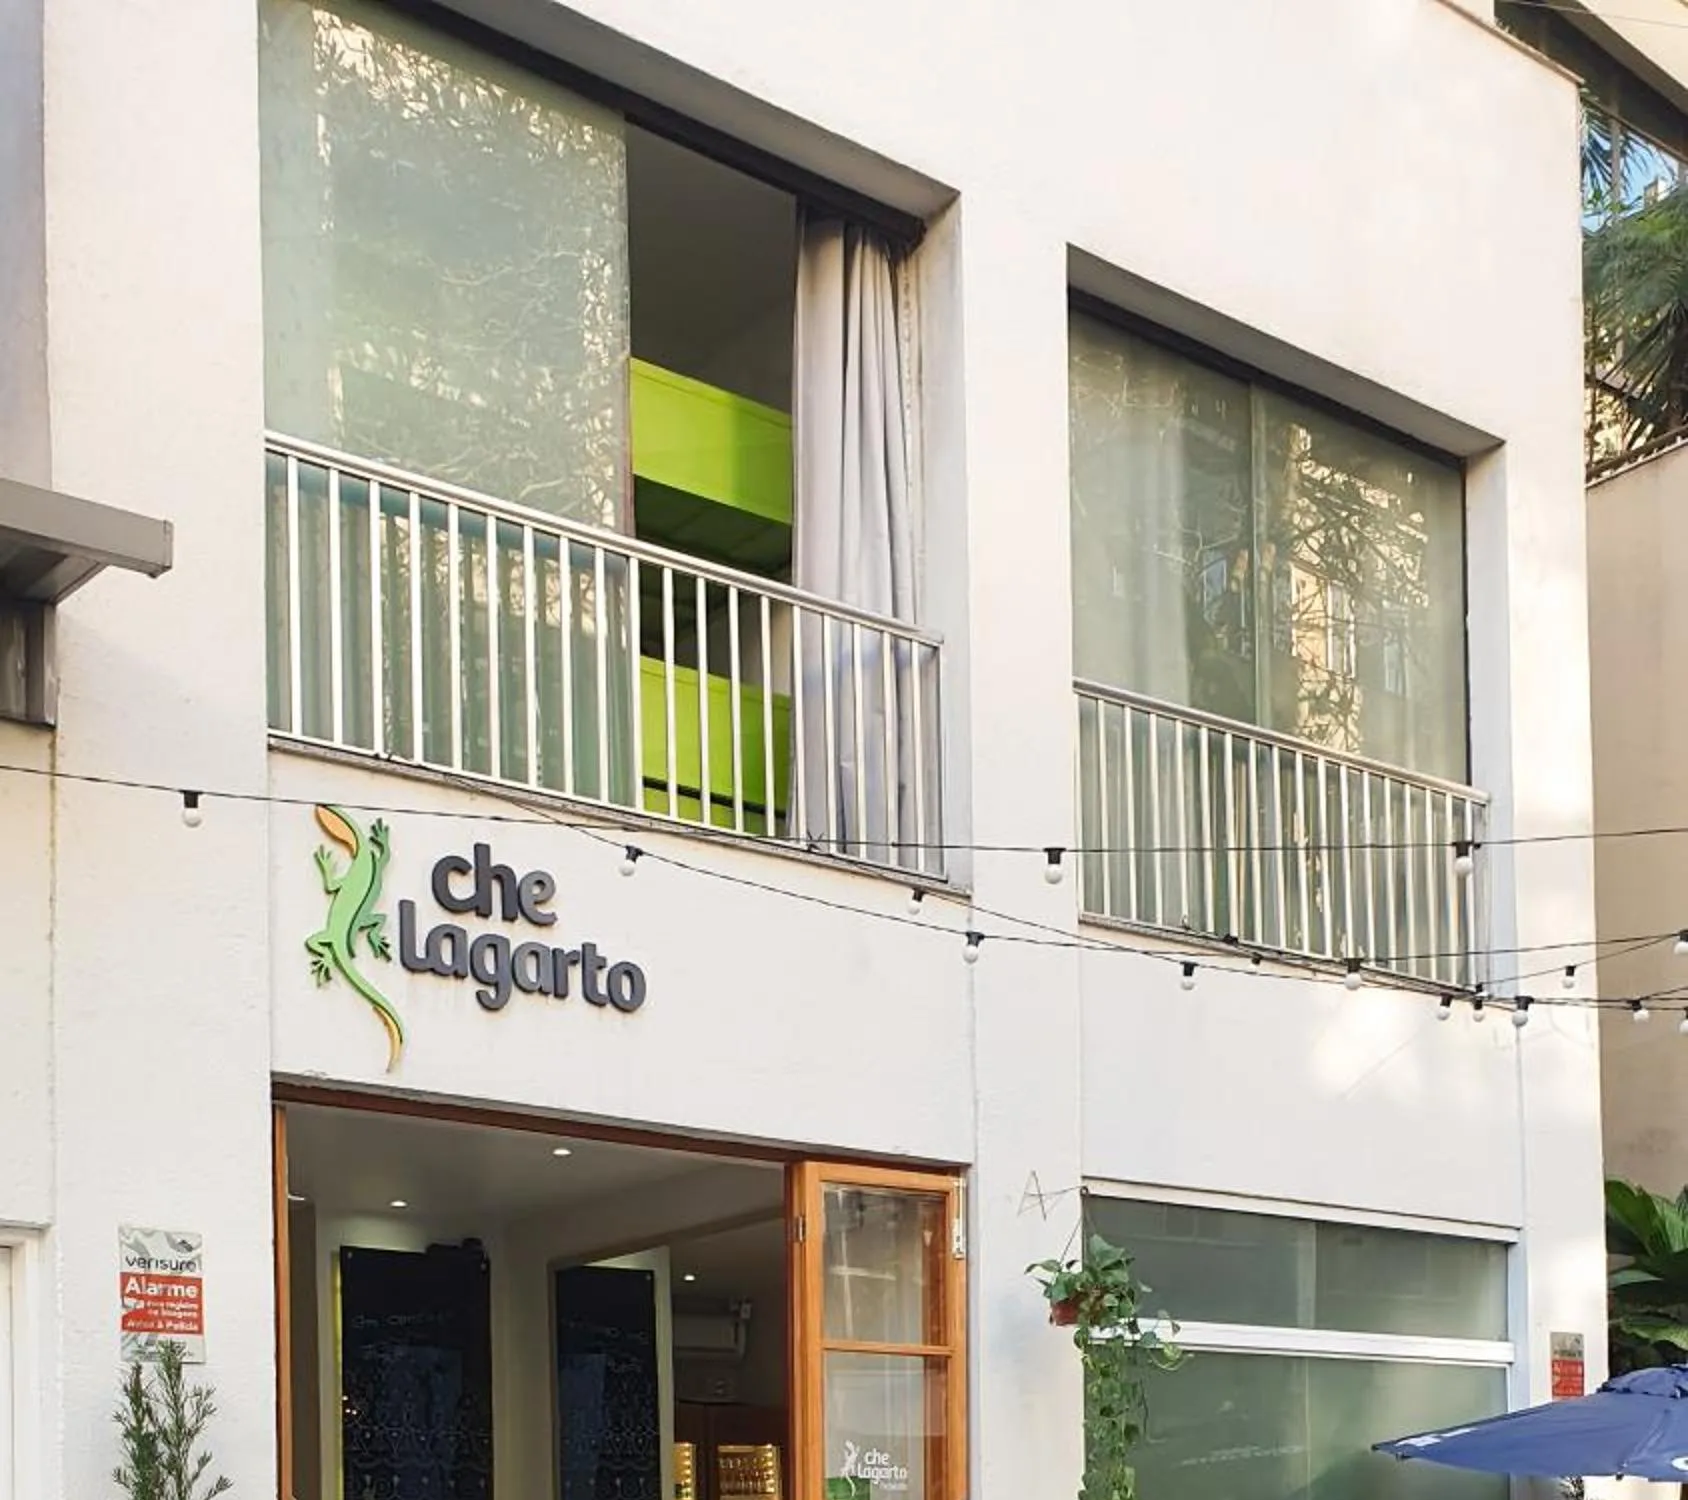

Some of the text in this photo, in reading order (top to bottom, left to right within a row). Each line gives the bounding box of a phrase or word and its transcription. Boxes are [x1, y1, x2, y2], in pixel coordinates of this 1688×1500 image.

[431, 843, 557, 926] che
[399, 900, 646, 1012] lagarto
[125, 1256, 197, 1272] verisure
[125, 1276, 198, 1298] Alarme
[864, 1448, 890, 1465] che
